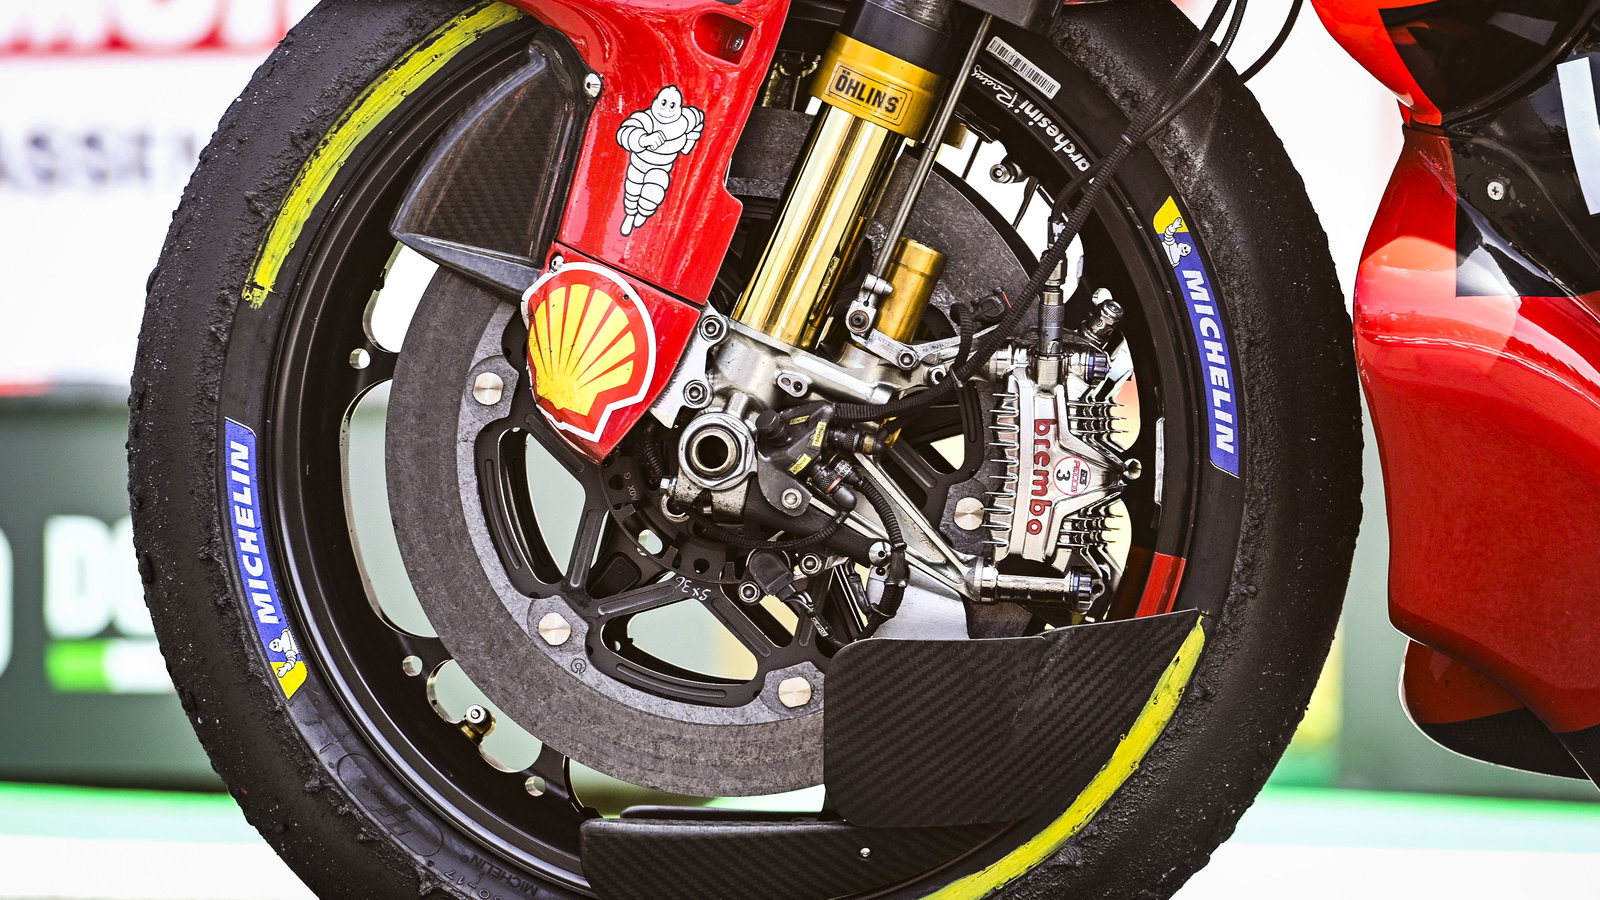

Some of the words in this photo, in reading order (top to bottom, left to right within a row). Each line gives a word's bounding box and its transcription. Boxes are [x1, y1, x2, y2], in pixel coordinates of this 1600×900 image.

[835, 70, 900, 114] ÖHLINS
[1182, 269, 1235, 454] MICHELIN
[230, 440, 281, 624] MICHELIN
[1027, 419, 1057, 535] brembo
[1056, 469, 1071, 482] 3
